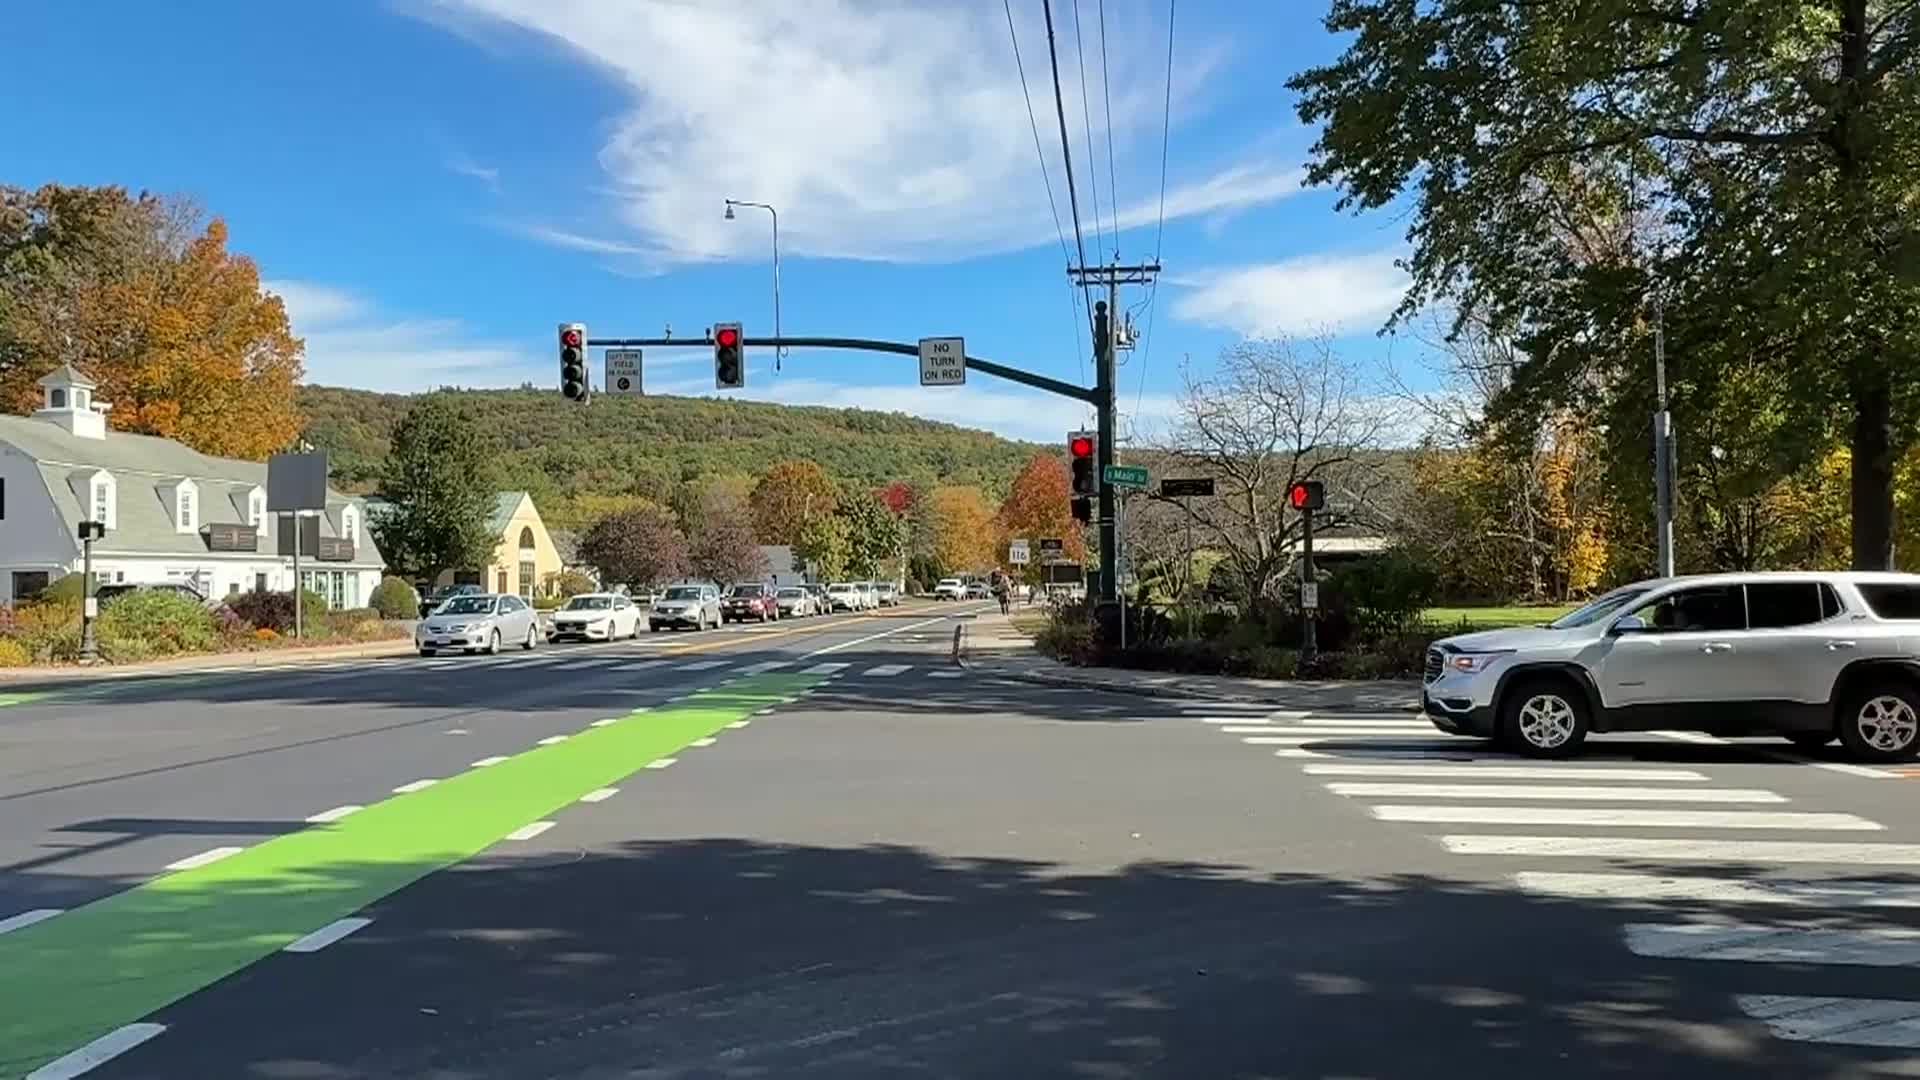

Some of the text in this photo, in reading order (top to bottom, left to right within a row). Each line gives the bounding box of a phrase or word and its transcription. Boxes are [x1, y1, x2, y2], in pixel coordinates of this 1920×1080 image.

[934, 343, 950, 353] NO
[930, 356, 955, 366] TURN
[924, 369, 961, 380] ON RED
[1114, 469, 1135, 481] Main
[1011, 551, 1027, 560] 116
